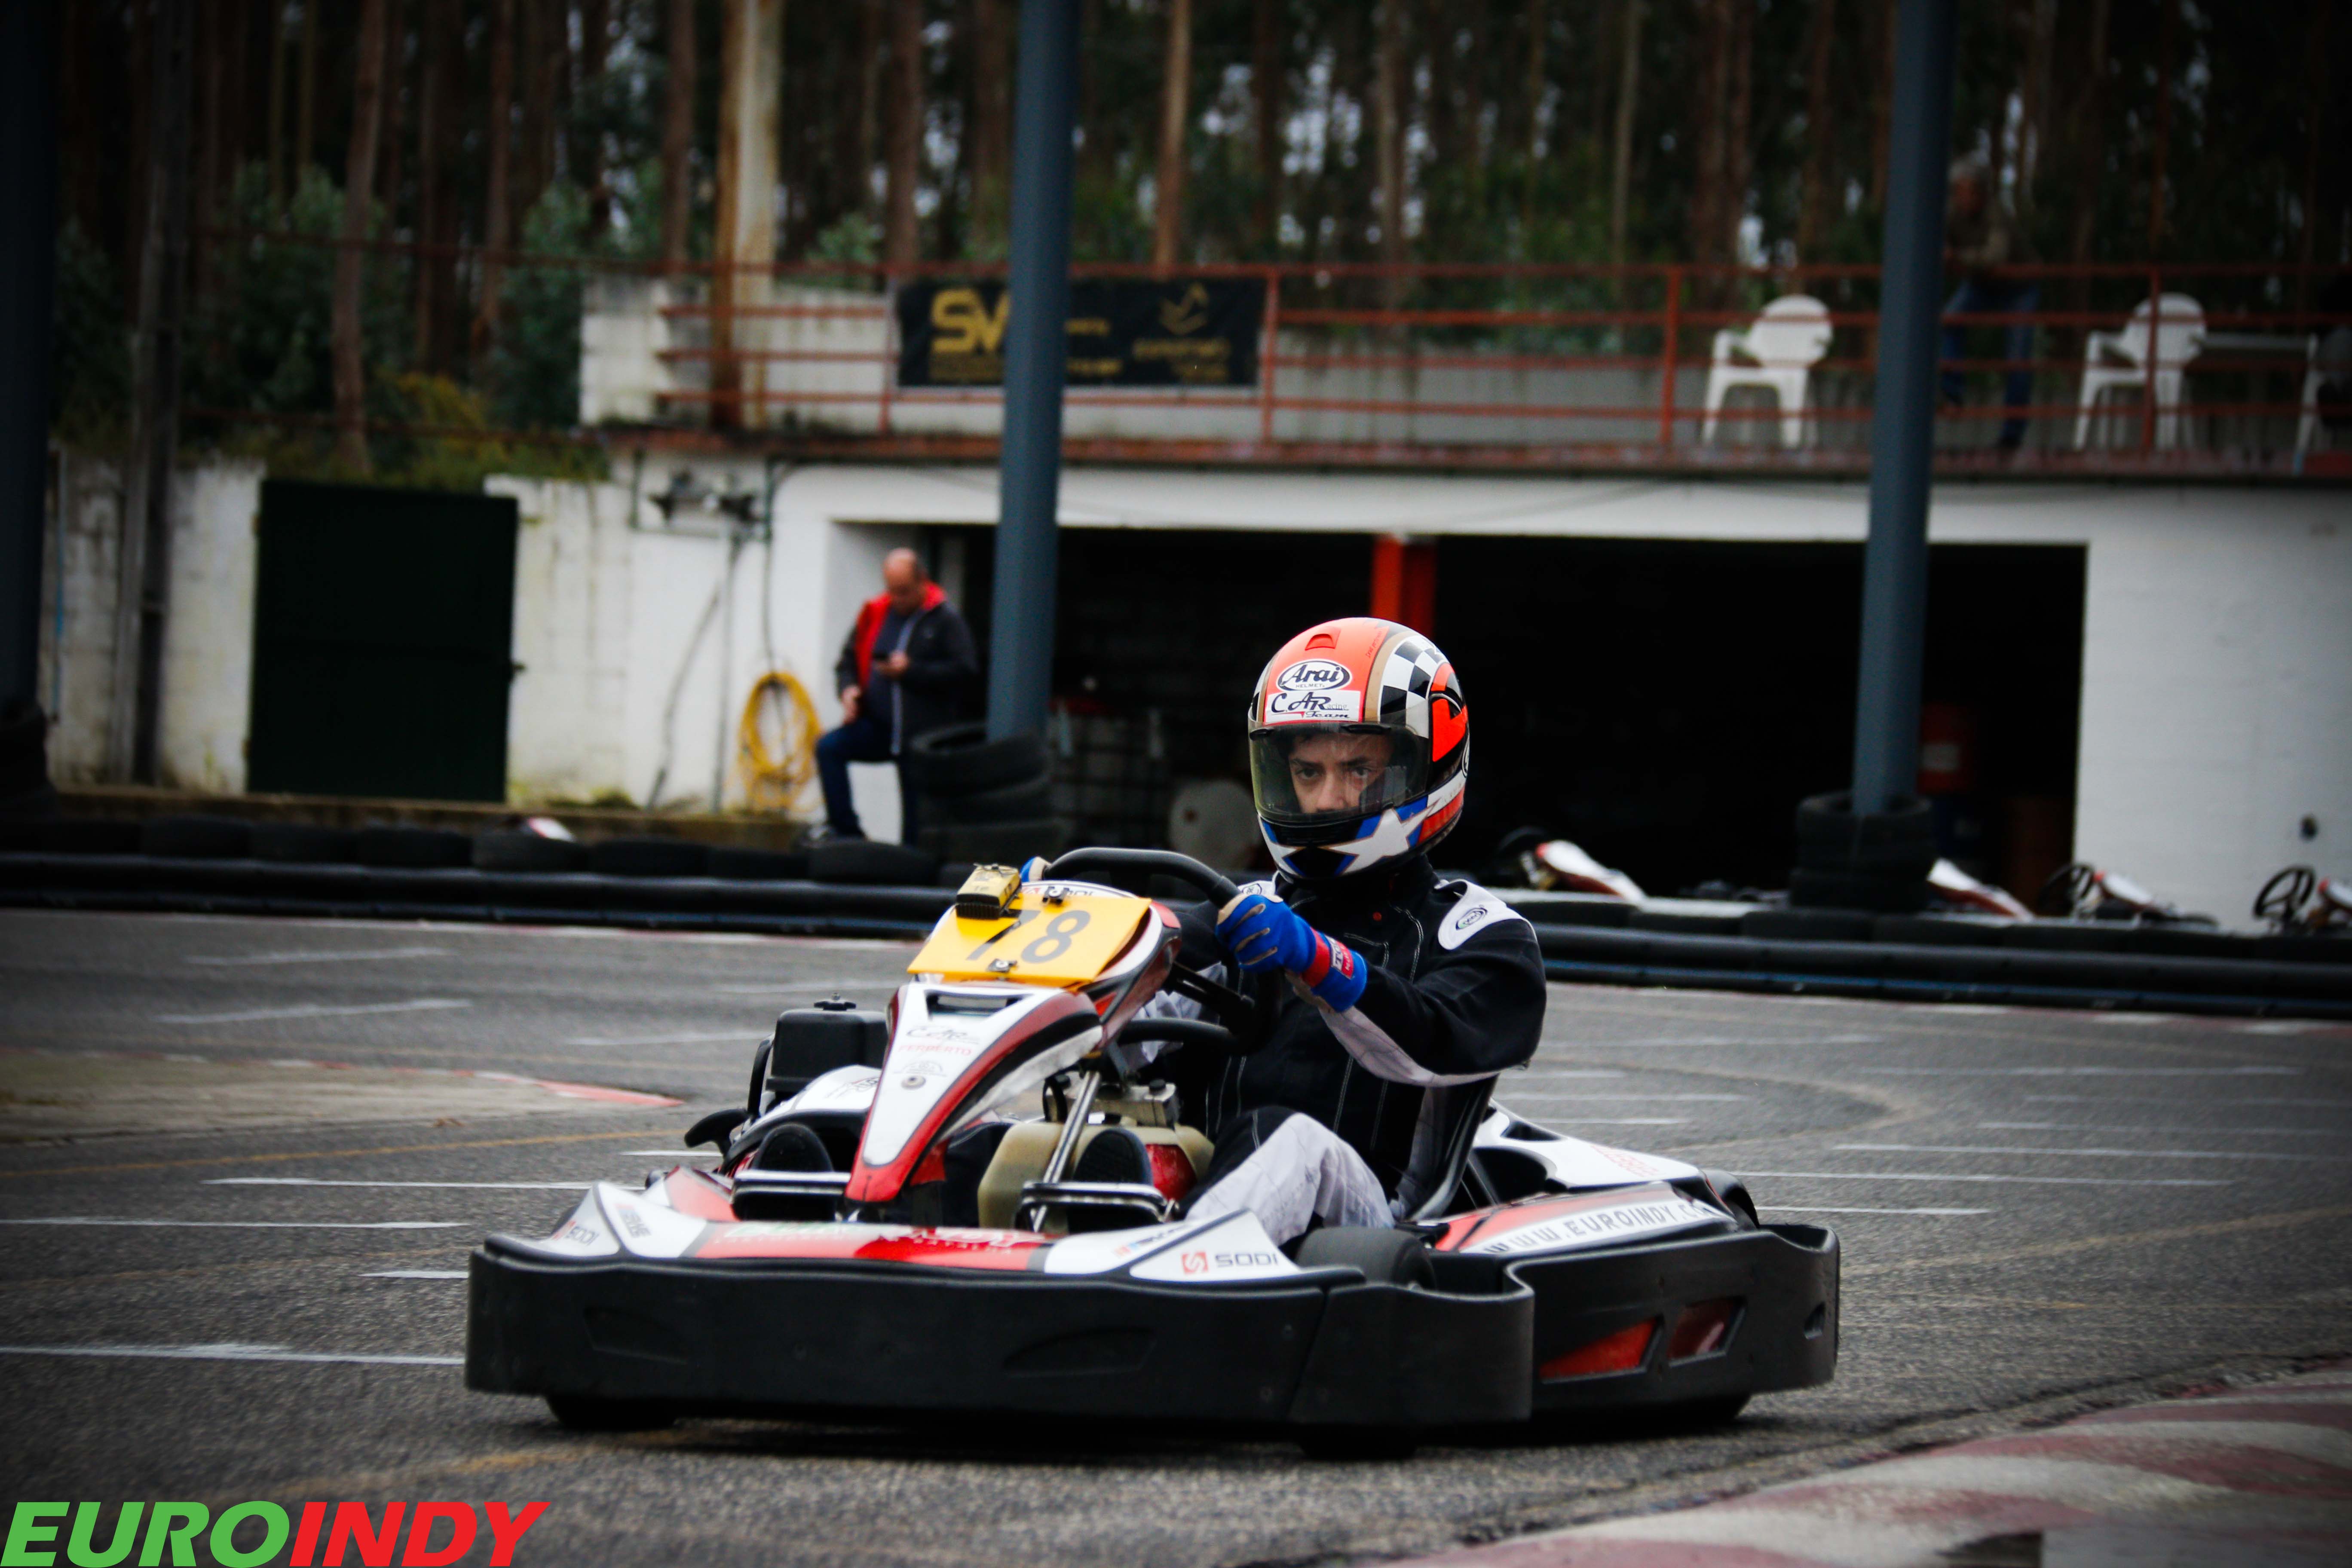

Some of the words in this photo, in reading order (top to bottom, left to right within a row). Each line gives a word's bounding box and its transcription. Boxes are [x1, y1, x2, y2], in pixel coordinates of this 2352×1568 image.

[1281, 665, 1341, 685] Arai
[966, 910, 1091, 963] 78
[1216, 1253, 1277, 1268] SODI
